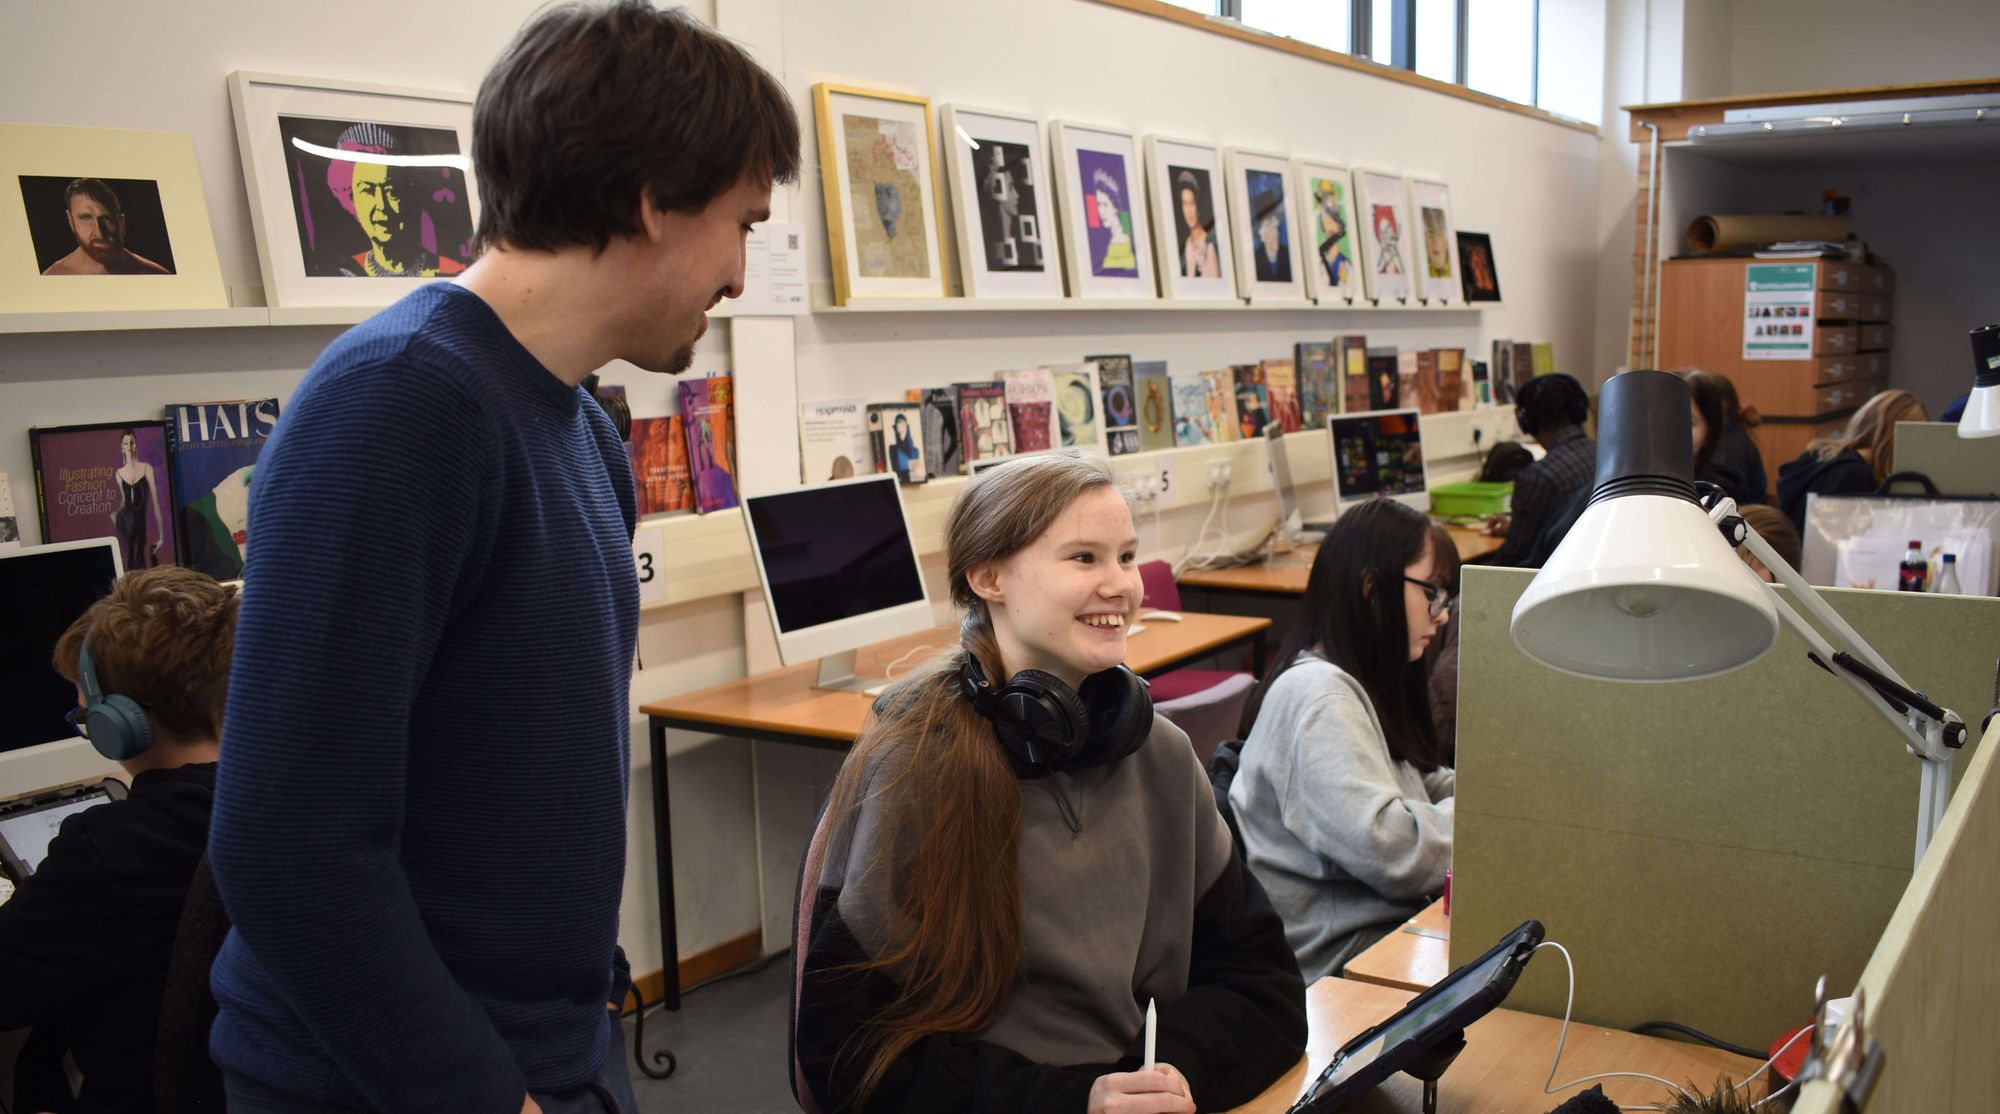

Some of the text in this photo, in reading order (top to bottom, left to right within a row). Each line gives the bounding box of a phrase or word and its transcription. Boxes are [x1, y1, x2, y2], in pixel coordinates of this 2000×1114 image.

[180, 401, 277, 442] HATS
[59, 466, 113, 480] Illustrating
[1161, 470, 1169, 491] 5
[65, 480, 106, 492] Fashion
[58, 489, 117, 504] Concept to
[67, 502, 112, 516] Creation
[638, 552, 655, 583] 3
